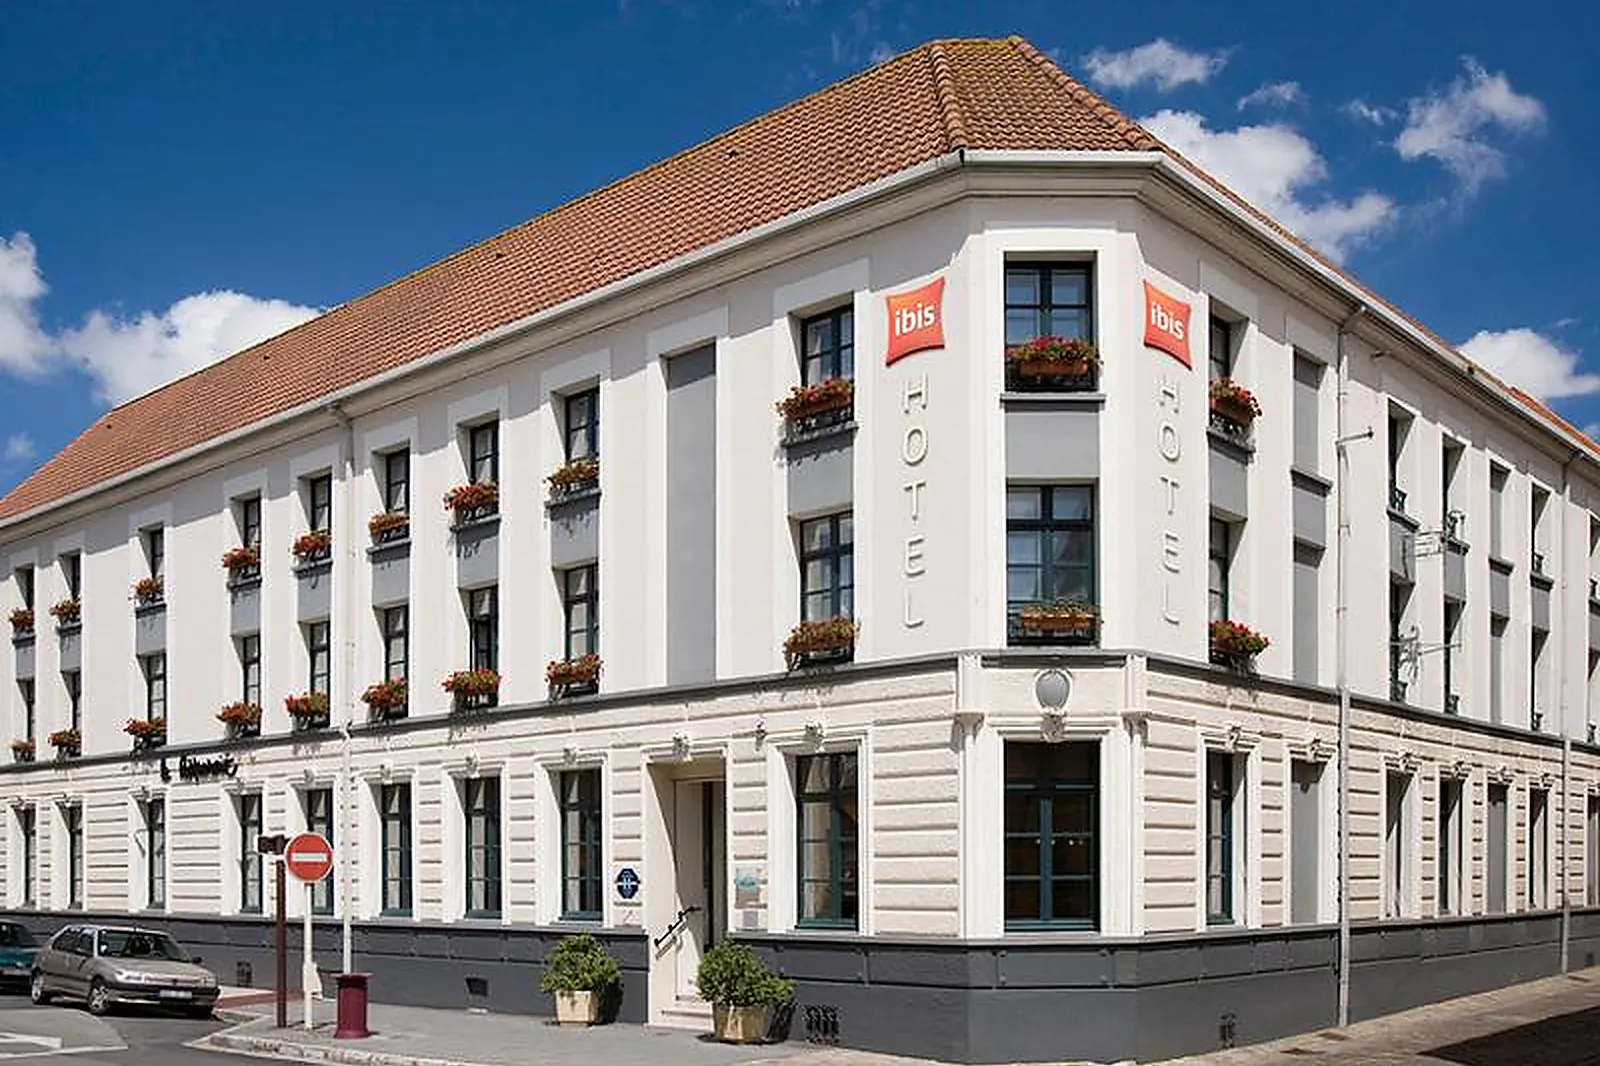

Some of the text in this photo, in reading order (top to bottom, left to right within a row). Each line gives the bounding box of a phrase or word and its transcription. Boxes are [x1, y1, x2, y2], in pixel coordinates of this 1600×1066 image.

[895, 302, 935, 337] ibis
[1151, 301, 1184, 340] ibis
[903, 374, 928, 628] HOTEL
[1159, 375, 1181, 624] HOTEL
